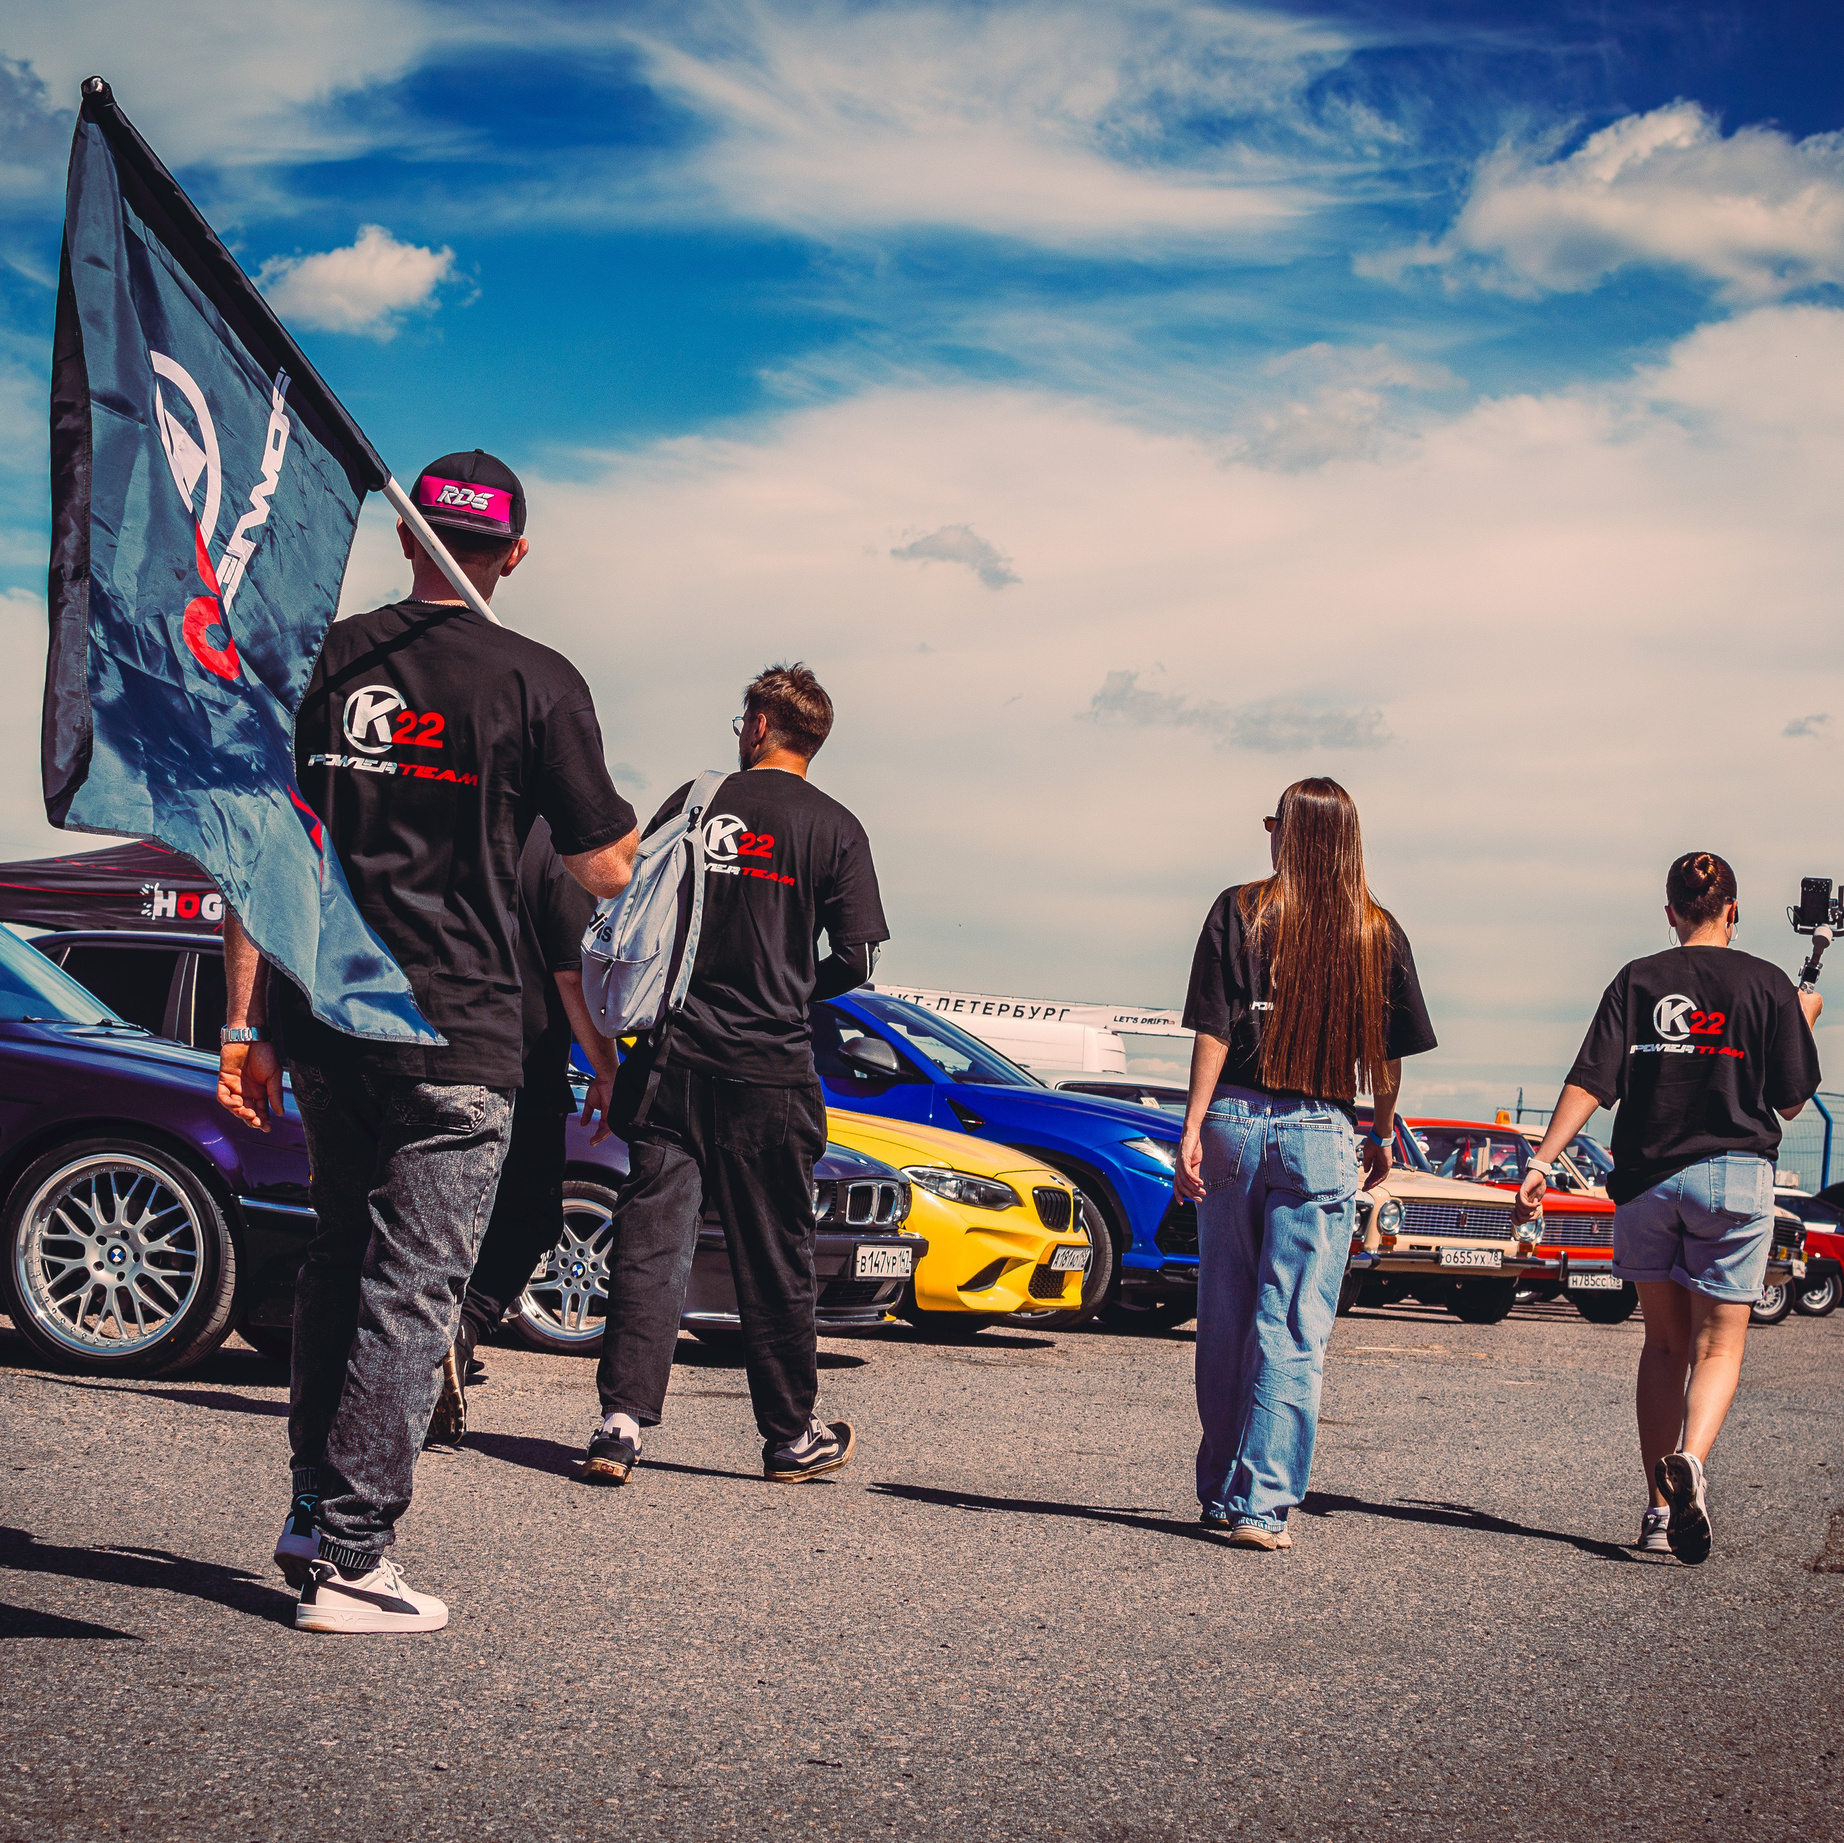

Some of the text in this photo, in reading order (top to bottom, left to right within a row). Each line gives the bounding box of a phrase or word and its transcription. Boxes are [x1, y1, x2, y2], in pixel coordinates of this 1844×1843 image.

[435, 484, 495, 511] RDS
[1113, 1015, 1139, 1024] LET'S
[1140, 1017, 1168, 1025] DRIFT
